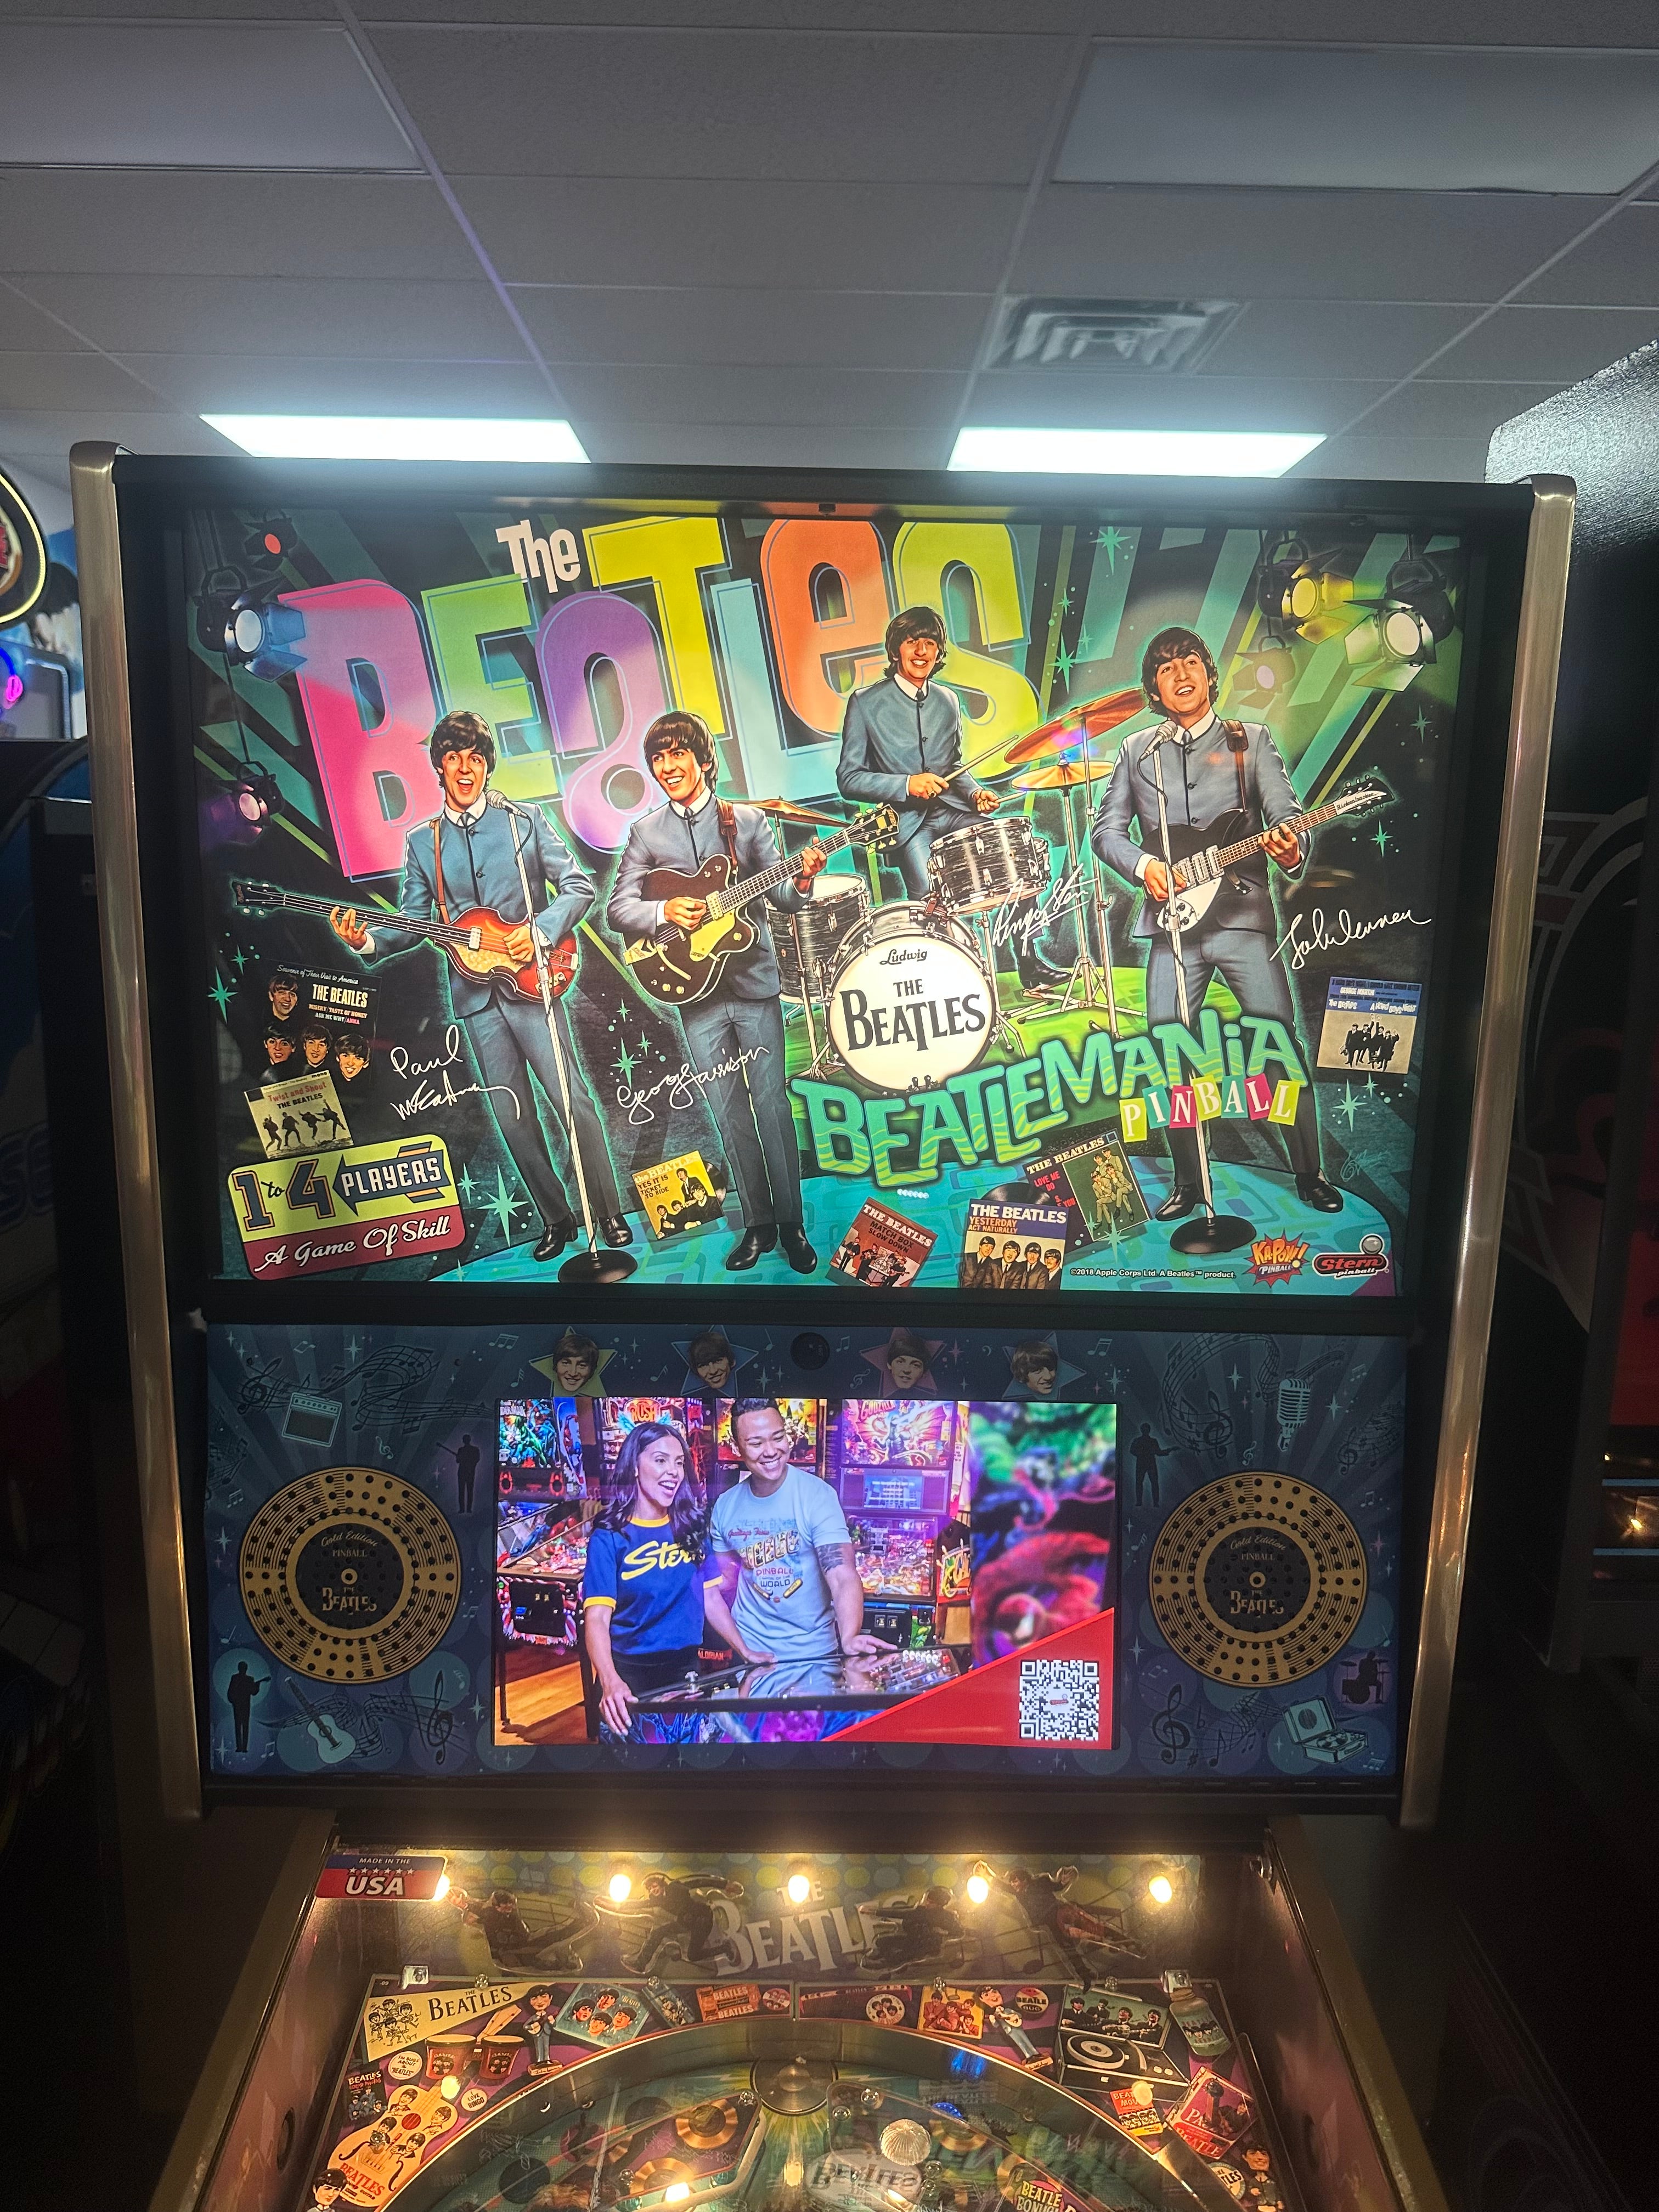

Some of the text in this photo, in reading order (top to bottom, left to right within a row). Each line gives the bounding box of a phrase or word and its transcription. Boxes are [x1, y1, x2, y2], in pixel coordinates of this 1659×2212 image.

[495, 520, 582, 594] The
[879, 949, 927, 965] Ludwig
[313, 984, 368, 1008] THE BEATLES
[893, 979, 924, 997] THE
[839, 989, 986, 1052] BEATLES
[390, 1024, 464, 1079] Paul
[267, 1092, 289, 1103] Twist
[291, 1088, 304, 1098] and
[306, 1081, 328, 1092] Shout
[293, 1093, 323, 1105] BEATLES
[791, 1008, 1307, 1188] BEATLEMANIA
[1123, 1079, 1297, 1139] PINBALL
[1026, 1137, 1105, 1175] THE BEATLES
[637, 1180, 652, 1189] YES
[1034, 1171, 1060, 1187] LOVE ME
[1046, 1182, 1056, 1192] DO
[232, 1156, 442, 1232] 1 to 4 PLAYERS
[640, 1183, 662, 1195] TICKET
[656, 1186, 670, 1195] RIDE
[1063, 1198, 1076, 1207] YOU
[970, 1203, 1067, 1224] THE BEATLES
[862, 1204, 933, 1247] THE BEATLES
[969, 1216, 1018, 1228] YESTERDAY
[982, 1226, 1018, 1234] NATURALLY
[868, 1227, 909, 1252] SLOW DOWN
[870, 1221, 914, 1249] MATCH BOX
[254, 1216, 451, 1273] A Game Of Skill
[1259, 1265, 1292, 1275] PINBALL
[1321, 1257, 1379, 1271] Stern
[1336, 1267, 1375, 1277] pinball
[1119, 1269, 1142, 1278] Corps
[332, 1549, 368, 1558] PINBALL
[621, 1541, 692, 1581] Ster
[756, 1567, 794, 1576] PINBALL
[760, 1579, 791, 1587] WORLD
[346, 1876, 404, 1896] USA
[713, 1986, 748, 2000] BEATLES
[427, 1985, 512, 2022] BEATLES
[718, 2004, 754, 2019] BEATLES
[348, 2070, 382, 2085] BEATLES
[467, 2093, 481, 2101] LOVE
[467, 2097, 484, 2109] RINGO
[340, 2162, 385, 2196] BEATLES
[1022, 2180, 1063, 2207] BEATLE
